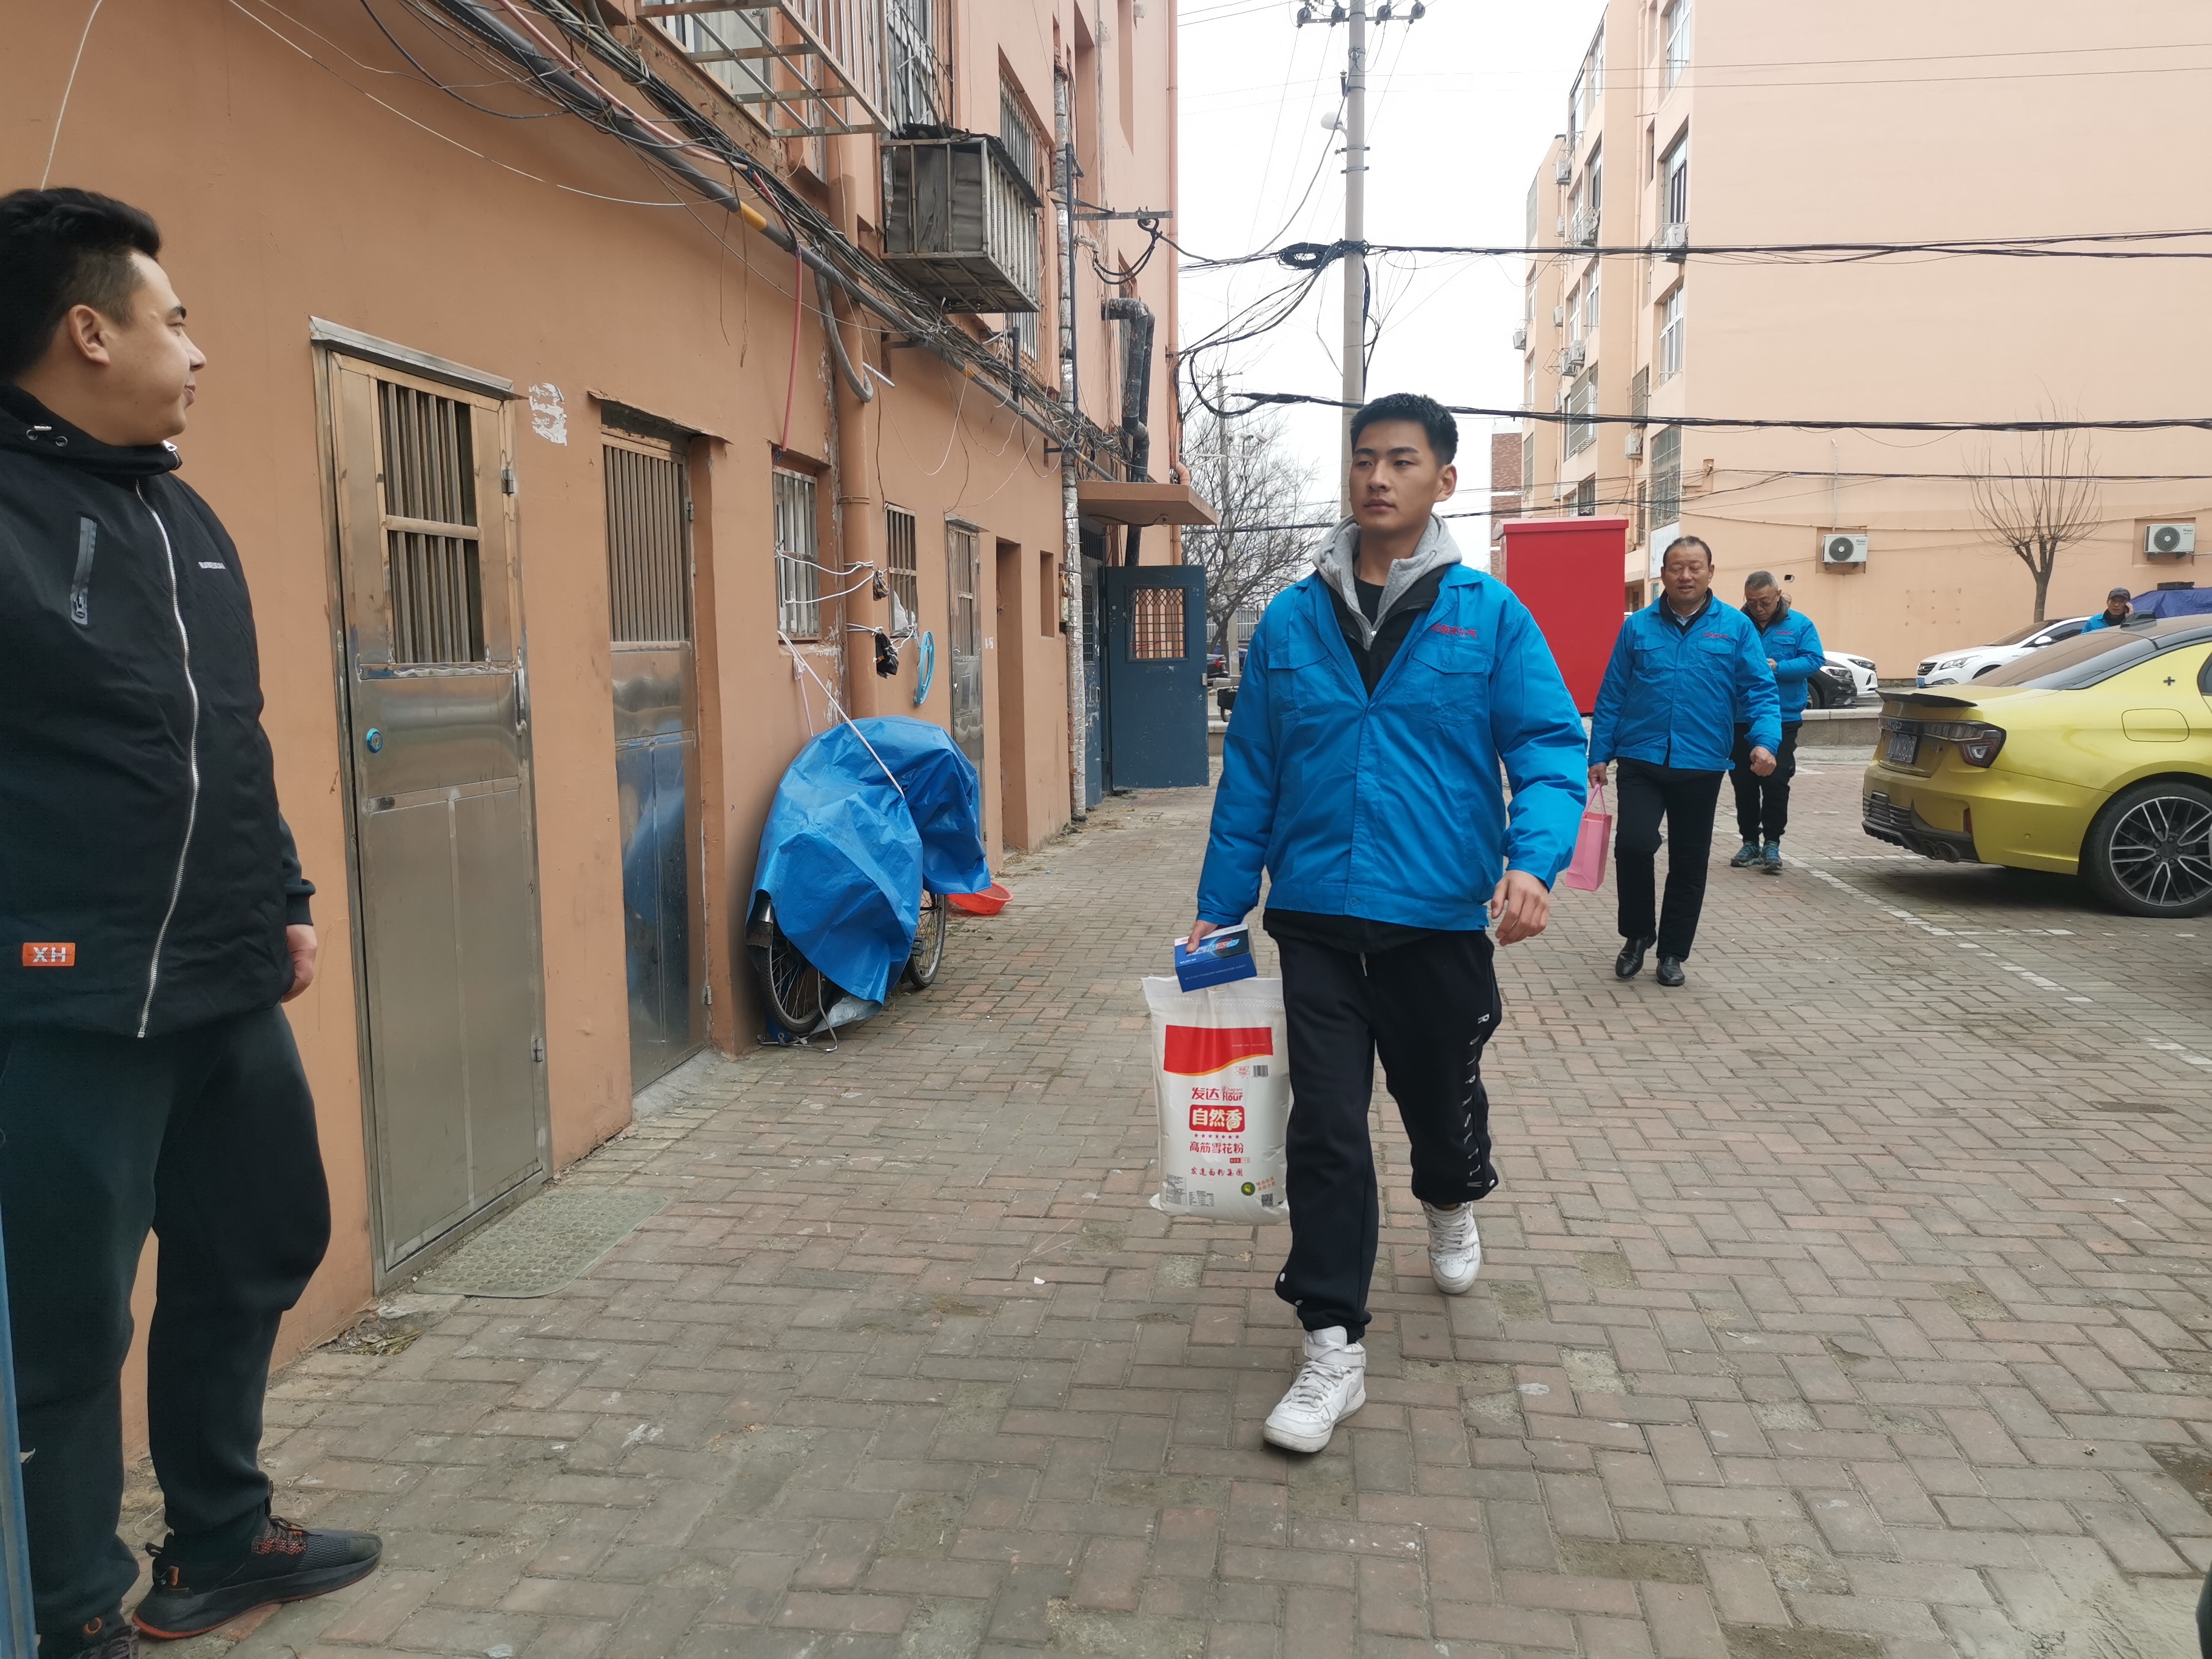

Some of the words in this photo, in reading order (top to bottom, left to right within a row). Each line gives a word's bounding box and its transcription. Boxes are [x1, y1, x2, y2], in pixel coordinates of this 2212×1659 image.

[33, 947, 66, 962] XH
[1191, 1087, 1220, 1100] 发达
[1192, 1108, 1242, 1131] 自然香
[1189, 1141, 1244, 1154] 高筋雪花粉
